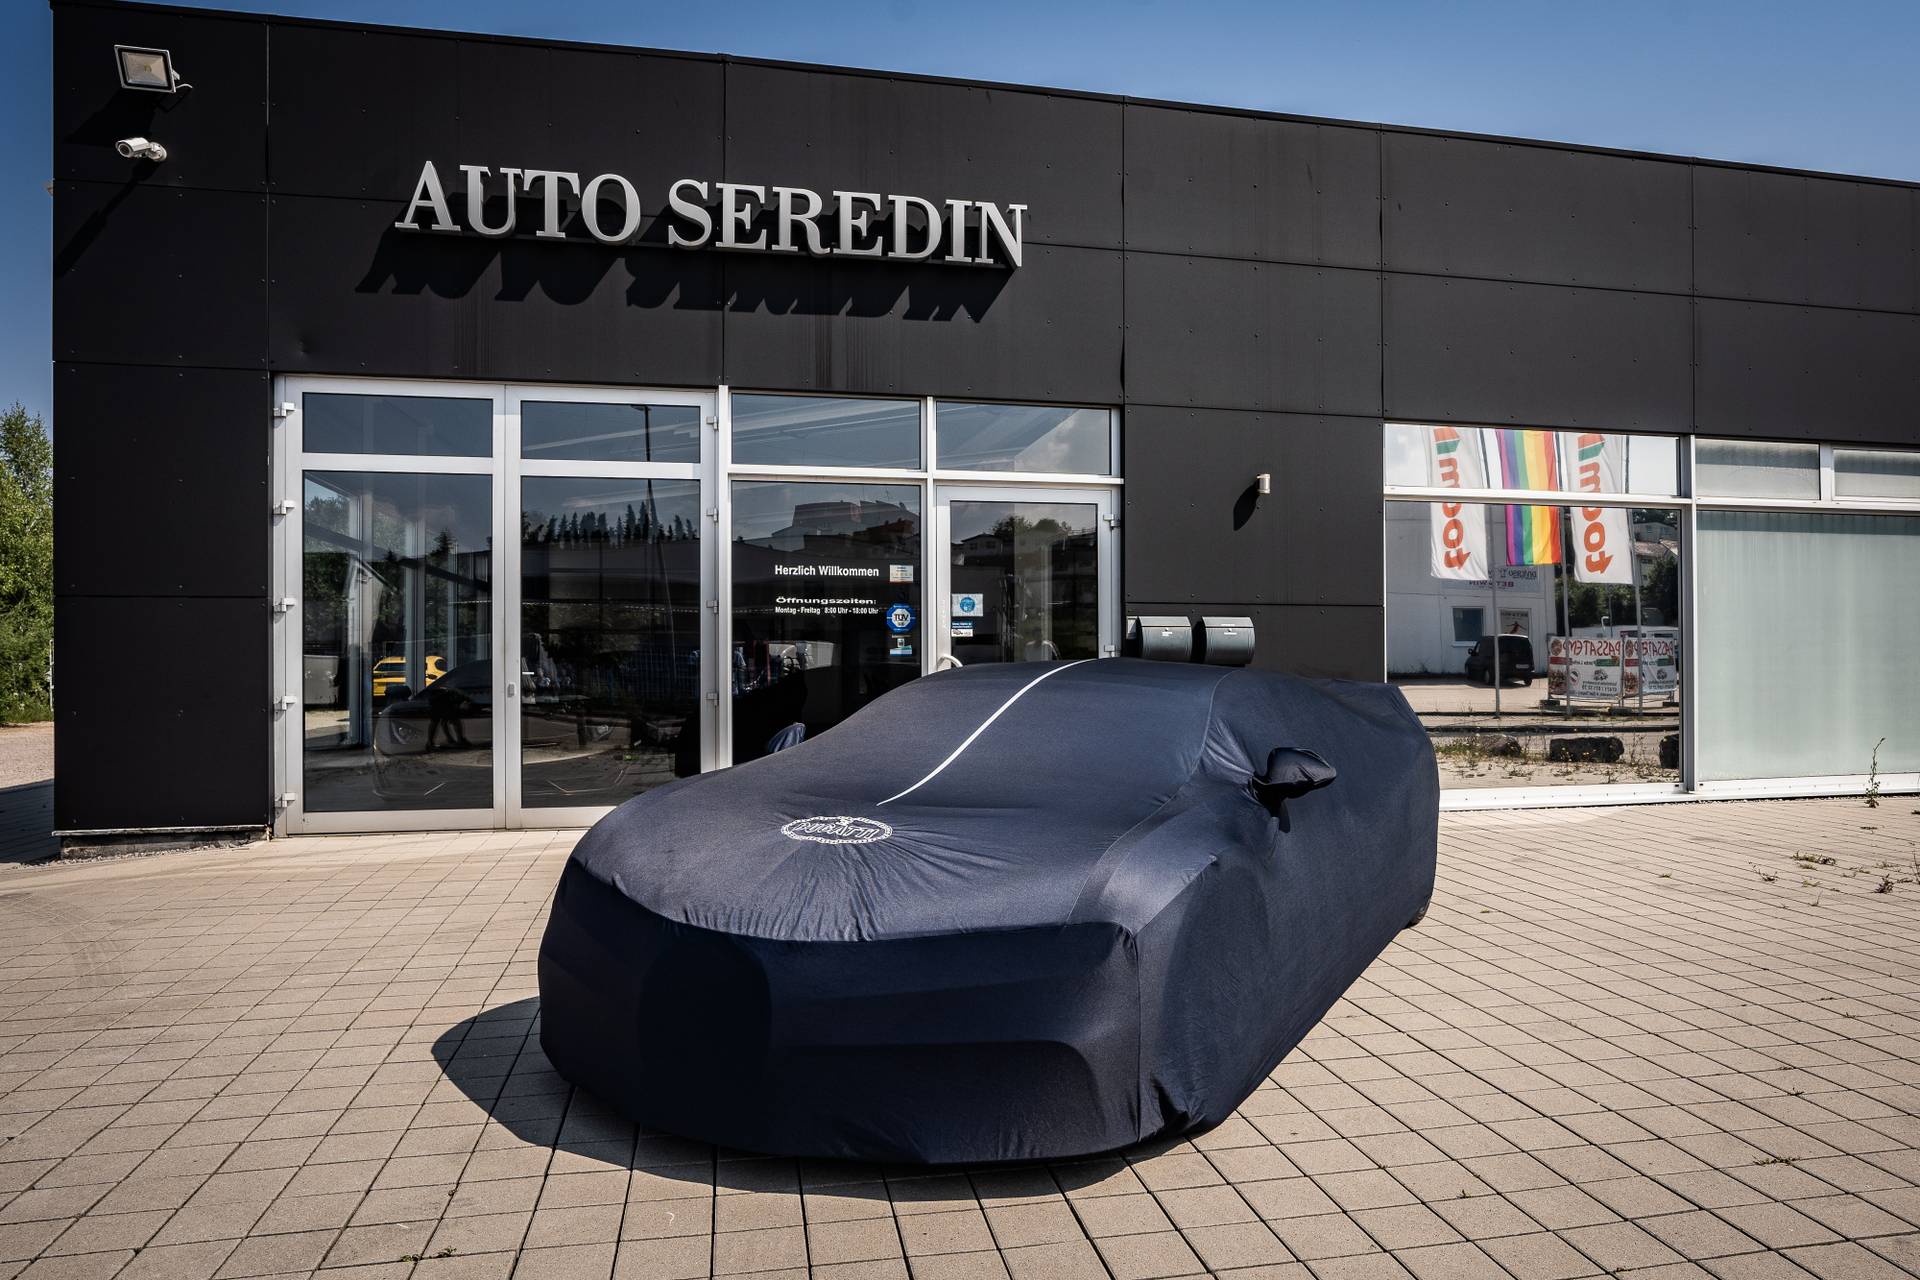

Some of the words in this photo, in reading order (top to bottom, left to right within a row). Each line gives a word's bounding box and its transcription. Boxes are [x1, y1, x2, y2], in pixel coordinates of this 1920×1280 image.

[394, 160, 641, 246] AUTO
[667, 178, 1029, 268] SEREDIN
[774, 564, 816, 576] Herzlich
[818, 565, 880, 577] Willkommen
[775, 596, 877, 605] Öffnungszeiten:
[775, 606, 797, 615] Montag
[800, 606, 821, 615] Freitag
